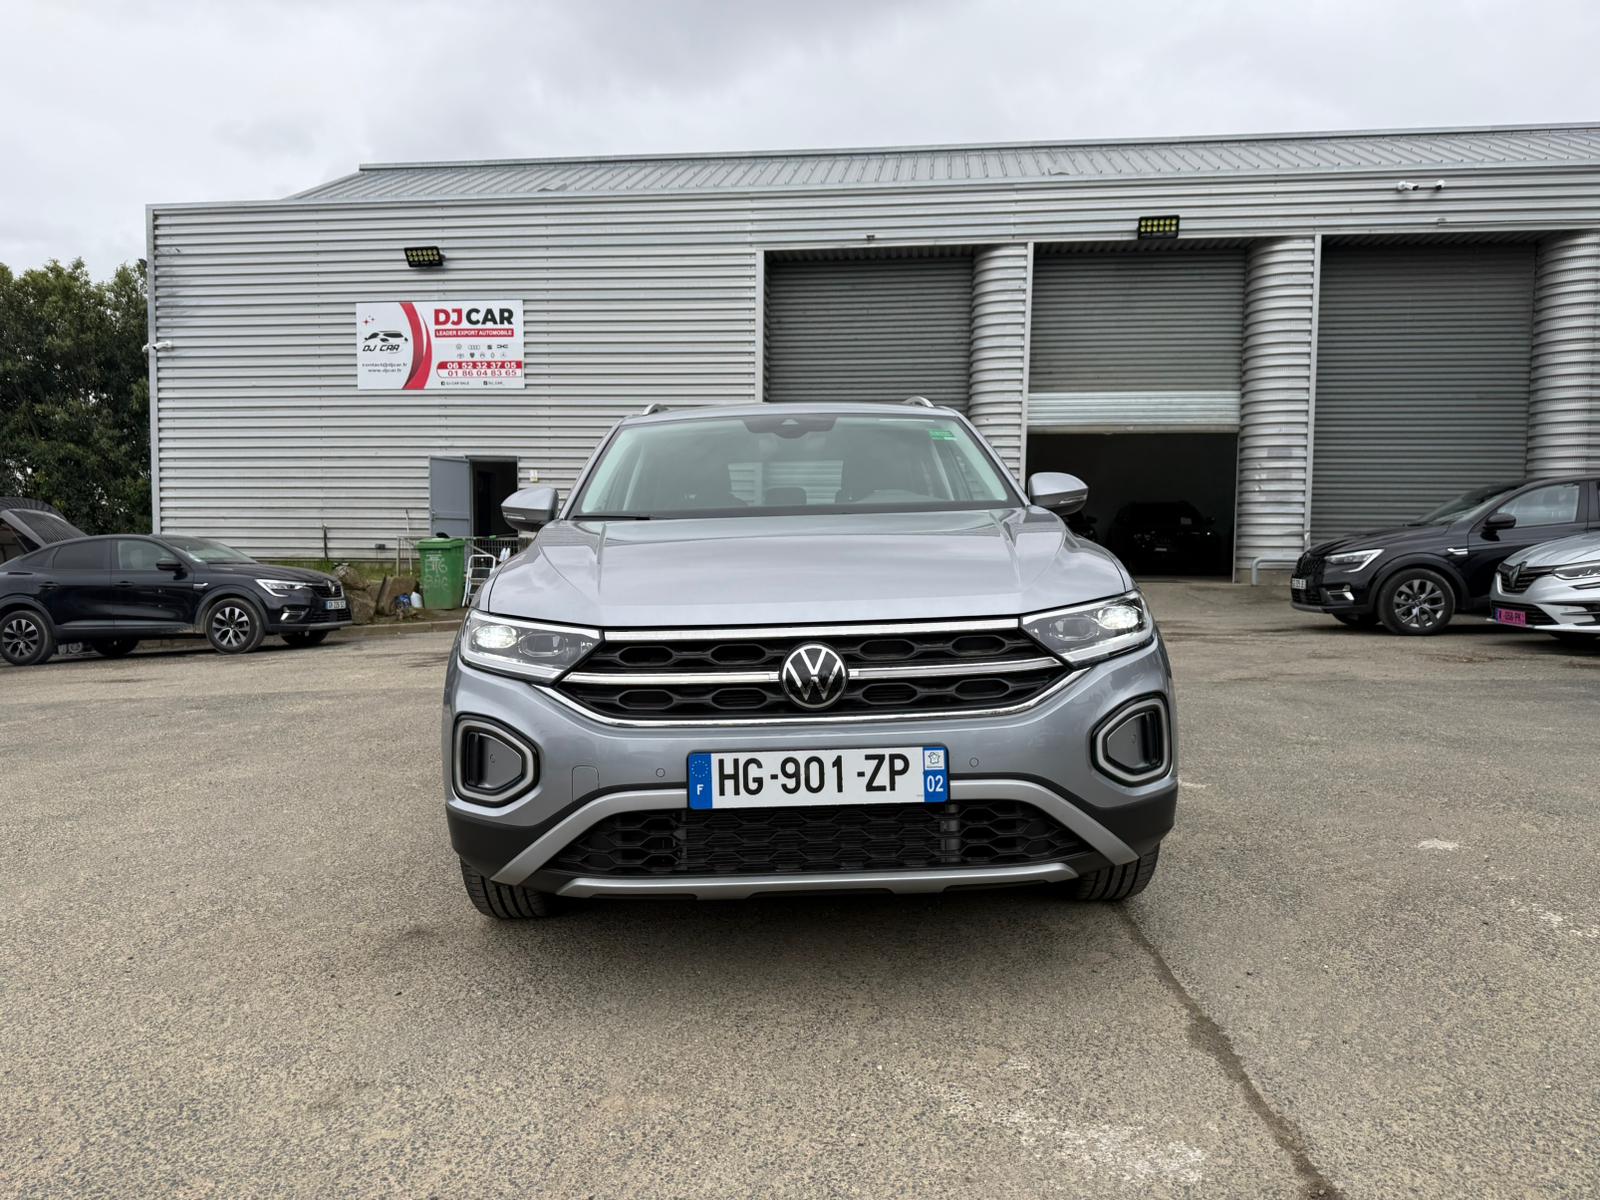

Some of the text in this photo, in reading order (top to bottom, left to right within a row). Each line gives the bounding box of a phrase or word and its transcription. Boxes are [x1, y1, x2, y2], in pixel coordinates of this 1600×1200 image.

[434, 308, 514, 326] DJ CAR
[379, 344, 400, 352] CAR
[696, 784, 704, 795] F
[926, 775, 944, 792] 02
